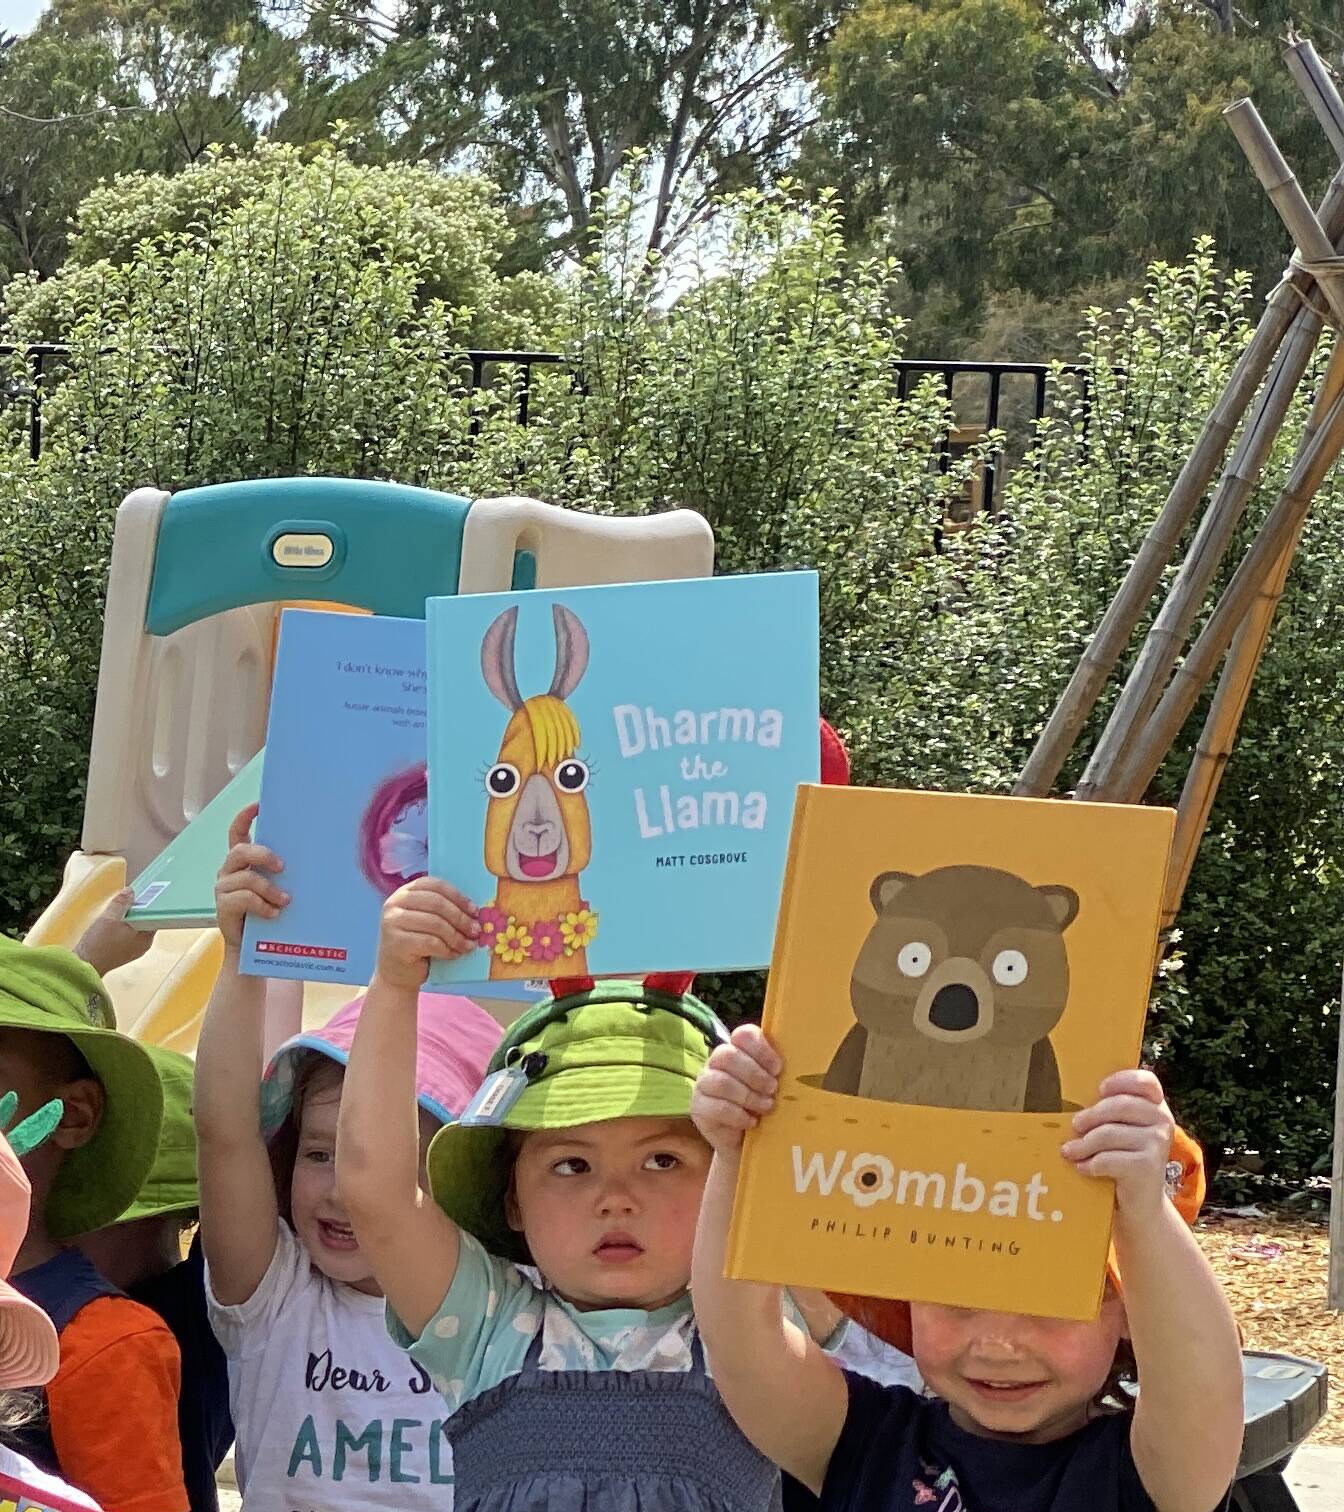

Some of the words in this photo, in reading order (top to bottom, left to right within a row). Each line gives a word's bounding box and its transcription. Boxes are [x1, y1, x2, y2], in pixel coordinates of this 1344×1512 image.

[613, 704, 783, 758] Dharma
[680, 754, 728, 780] the
[634, 785, 767, 838] Llama
[656, 856, 685, 867] MATT
[690, 852, 748, 866] COSGROVE
[269, 943, 345, 959] SCHOLASTIC
[791, 1146, 1063, 1222] Wombat.
[811, 1218, 892, 1240] PHILIP
[909, 1229, 1021, 1256] BUNTING
[305, 1347, 392, 1394] Dear
